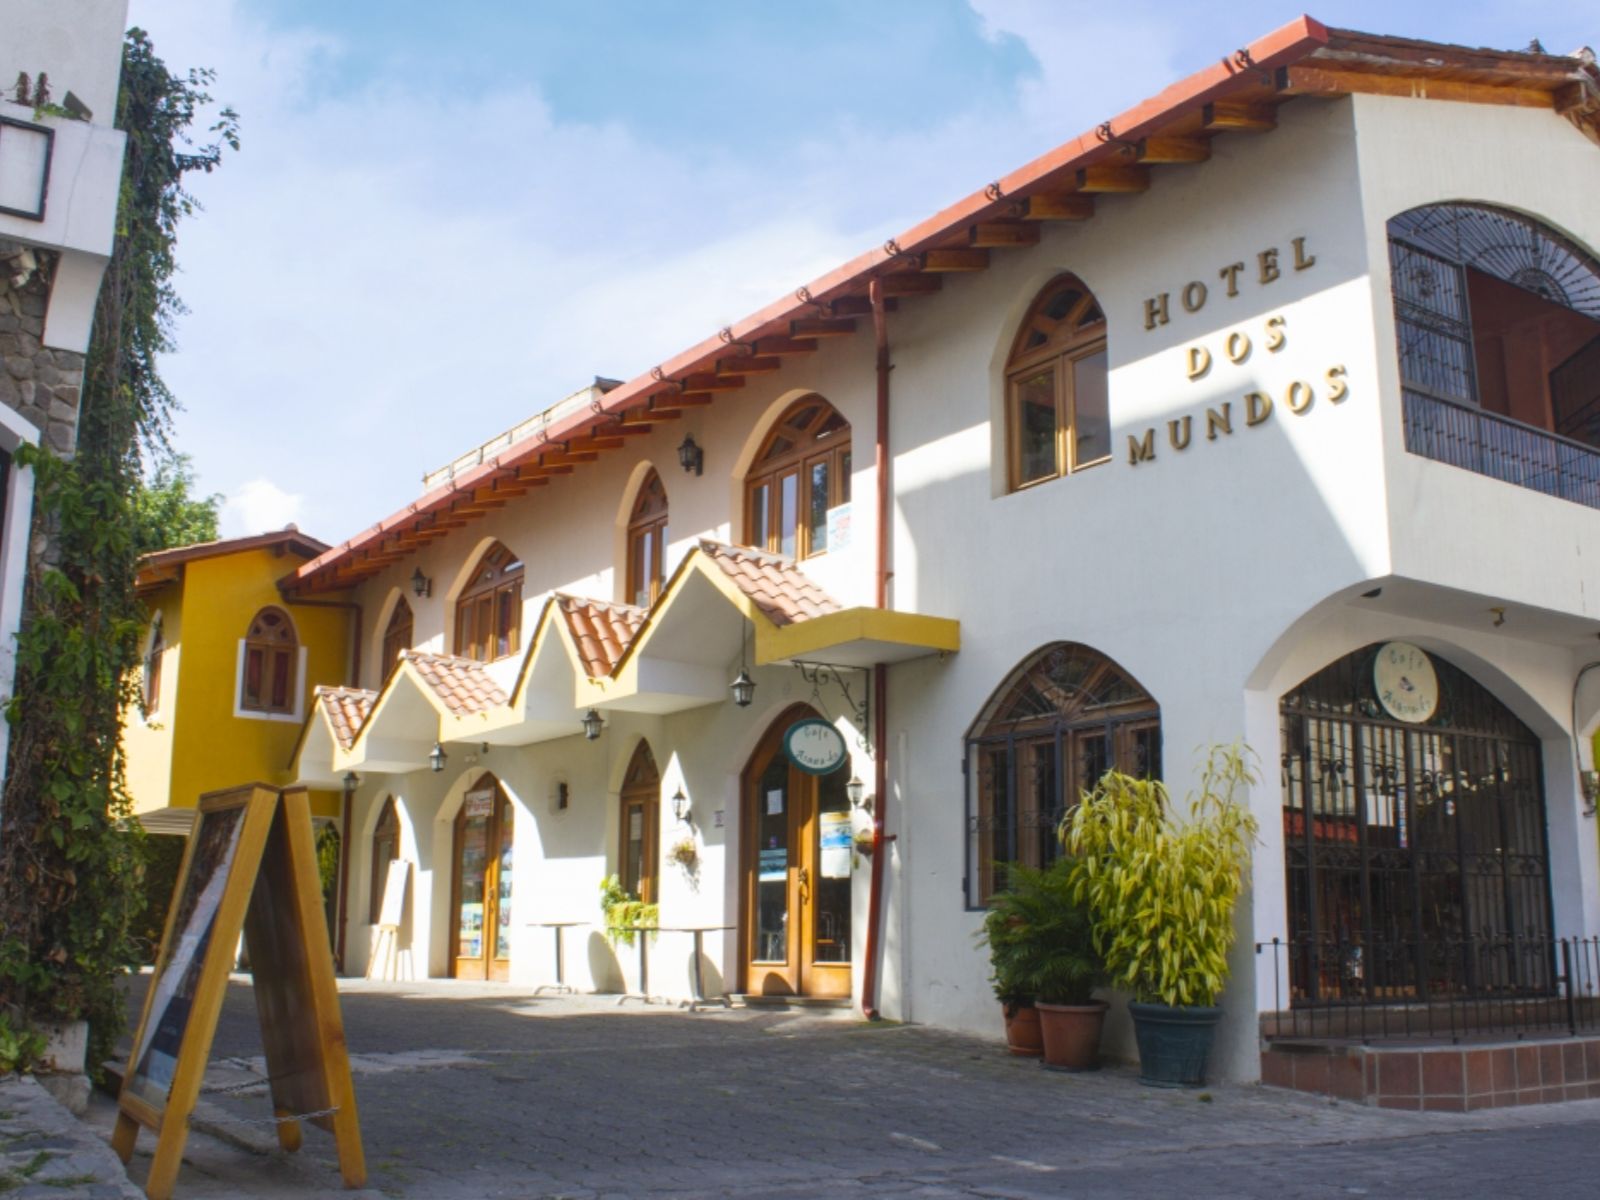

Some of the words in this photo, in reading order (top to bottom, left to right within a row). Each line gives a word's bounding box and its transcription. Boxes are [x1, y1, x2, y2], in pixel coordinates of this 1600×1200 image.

[1143, 236, 1317, 331] HOTEL
[1186, 315, 1287, 382] DOS
[1127, 364, 1348, 466] MUNDOS
